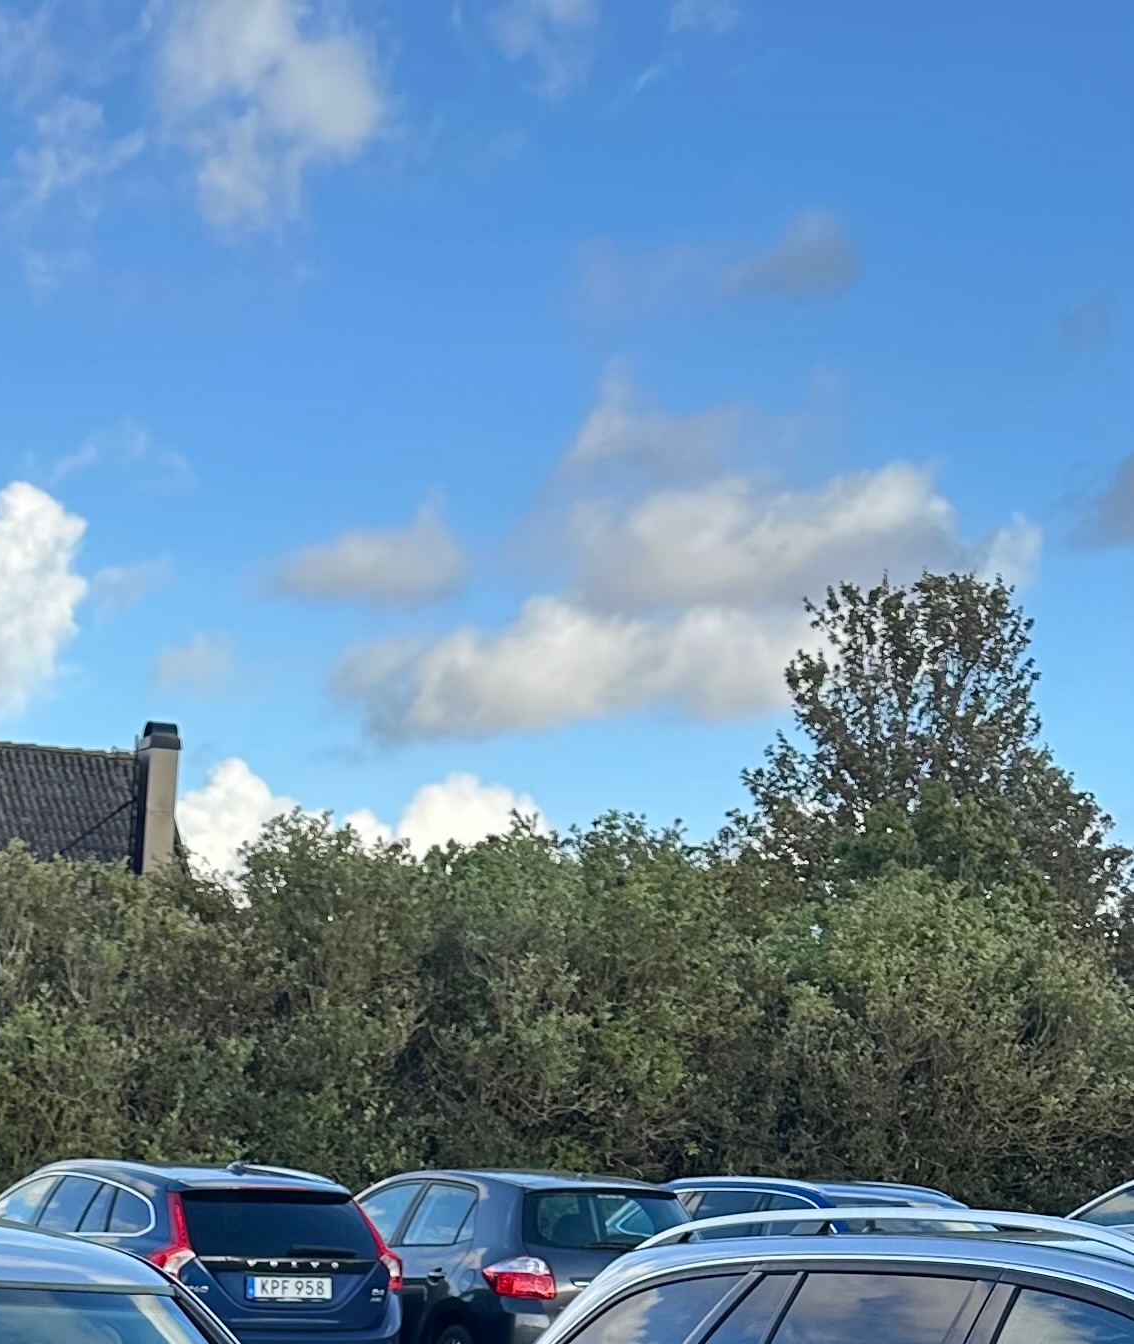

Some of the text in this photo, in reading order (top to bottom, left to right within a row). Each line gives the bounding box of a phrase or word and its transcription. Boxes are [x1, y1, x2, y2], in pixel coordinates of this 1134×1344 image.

[246, 1259, 340, 1270] VOLVO
[260, 1278, 325, 1297] KPF 958
